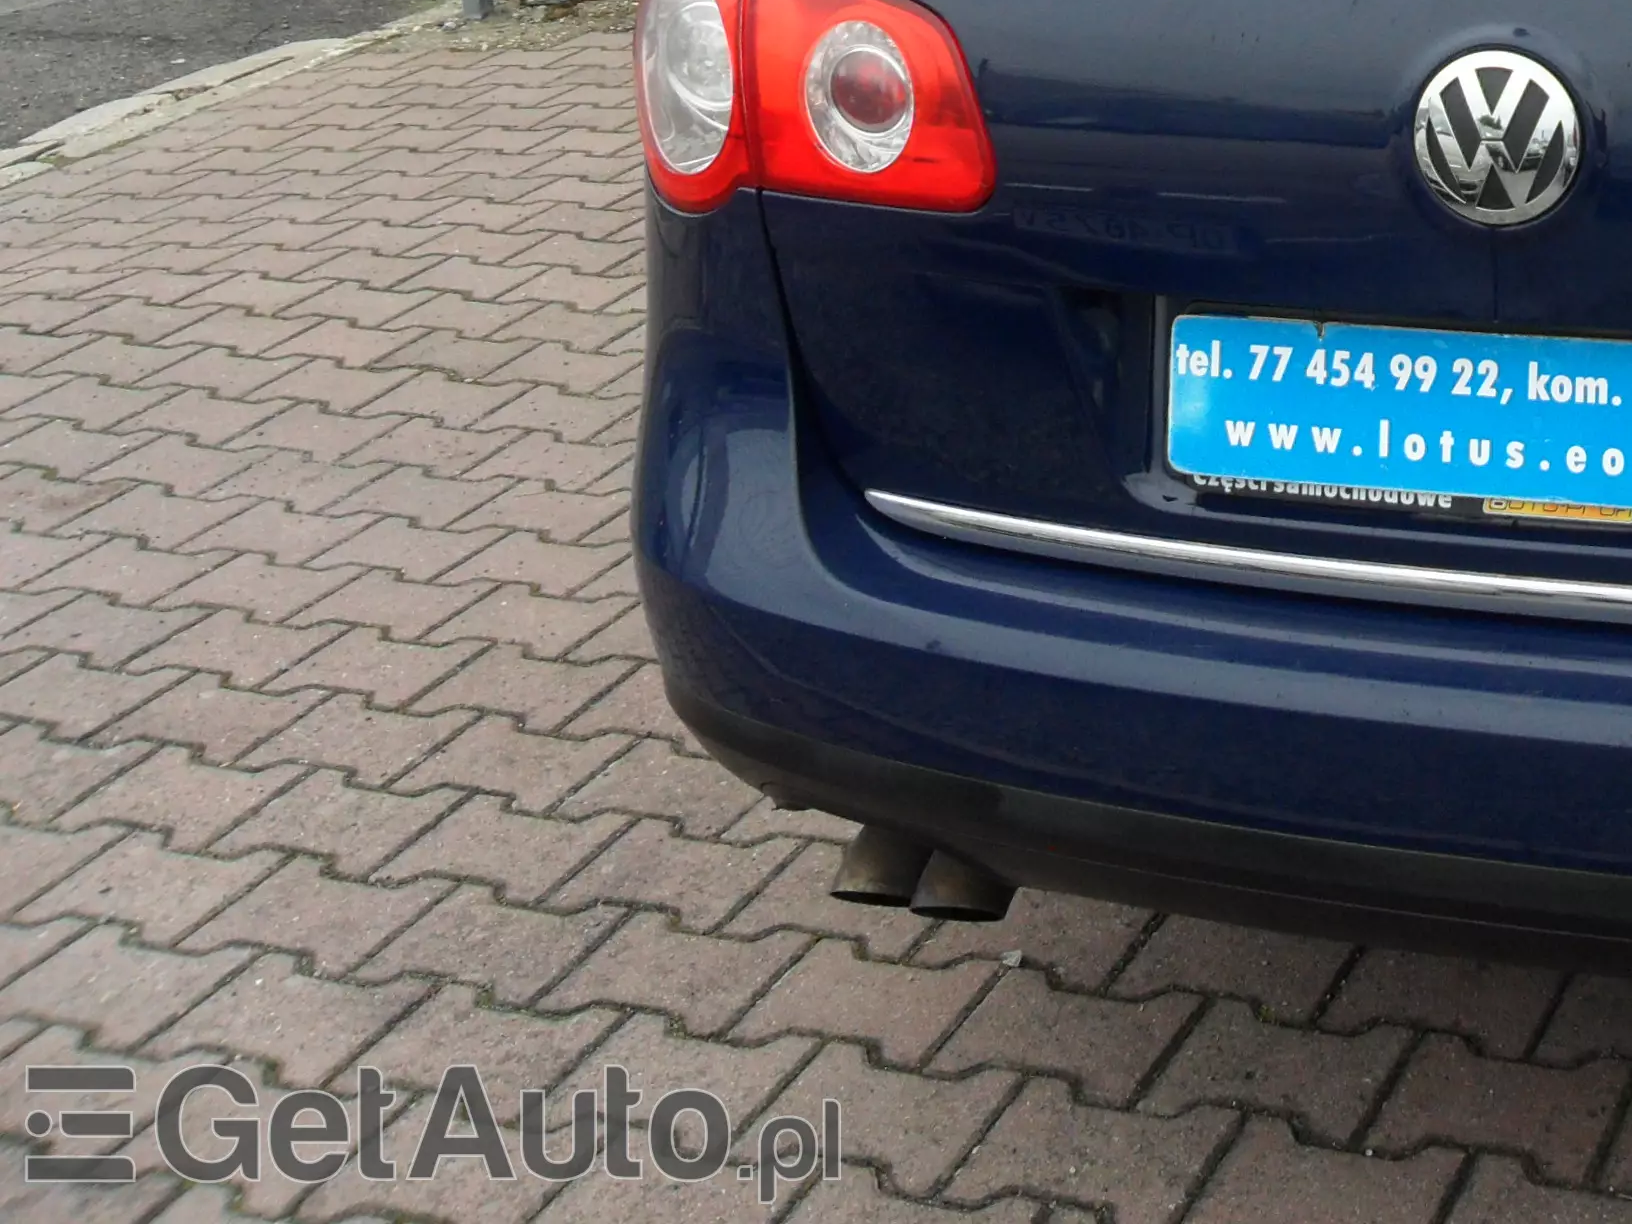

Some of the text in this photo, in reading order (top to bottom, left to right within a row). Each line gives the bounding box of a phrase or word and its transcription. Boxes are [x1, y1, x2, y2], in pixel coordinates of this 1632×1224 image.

[1176, 340, 1233, 379] tel.
[1248, 344, 1293, 382] 77
[1306, 348, 1376, 389] 454
[1389, 354, 1438, 393] 99
[1451, 358, 1513, 405] 22,
[1527, 361, 1622, 407] kom.
